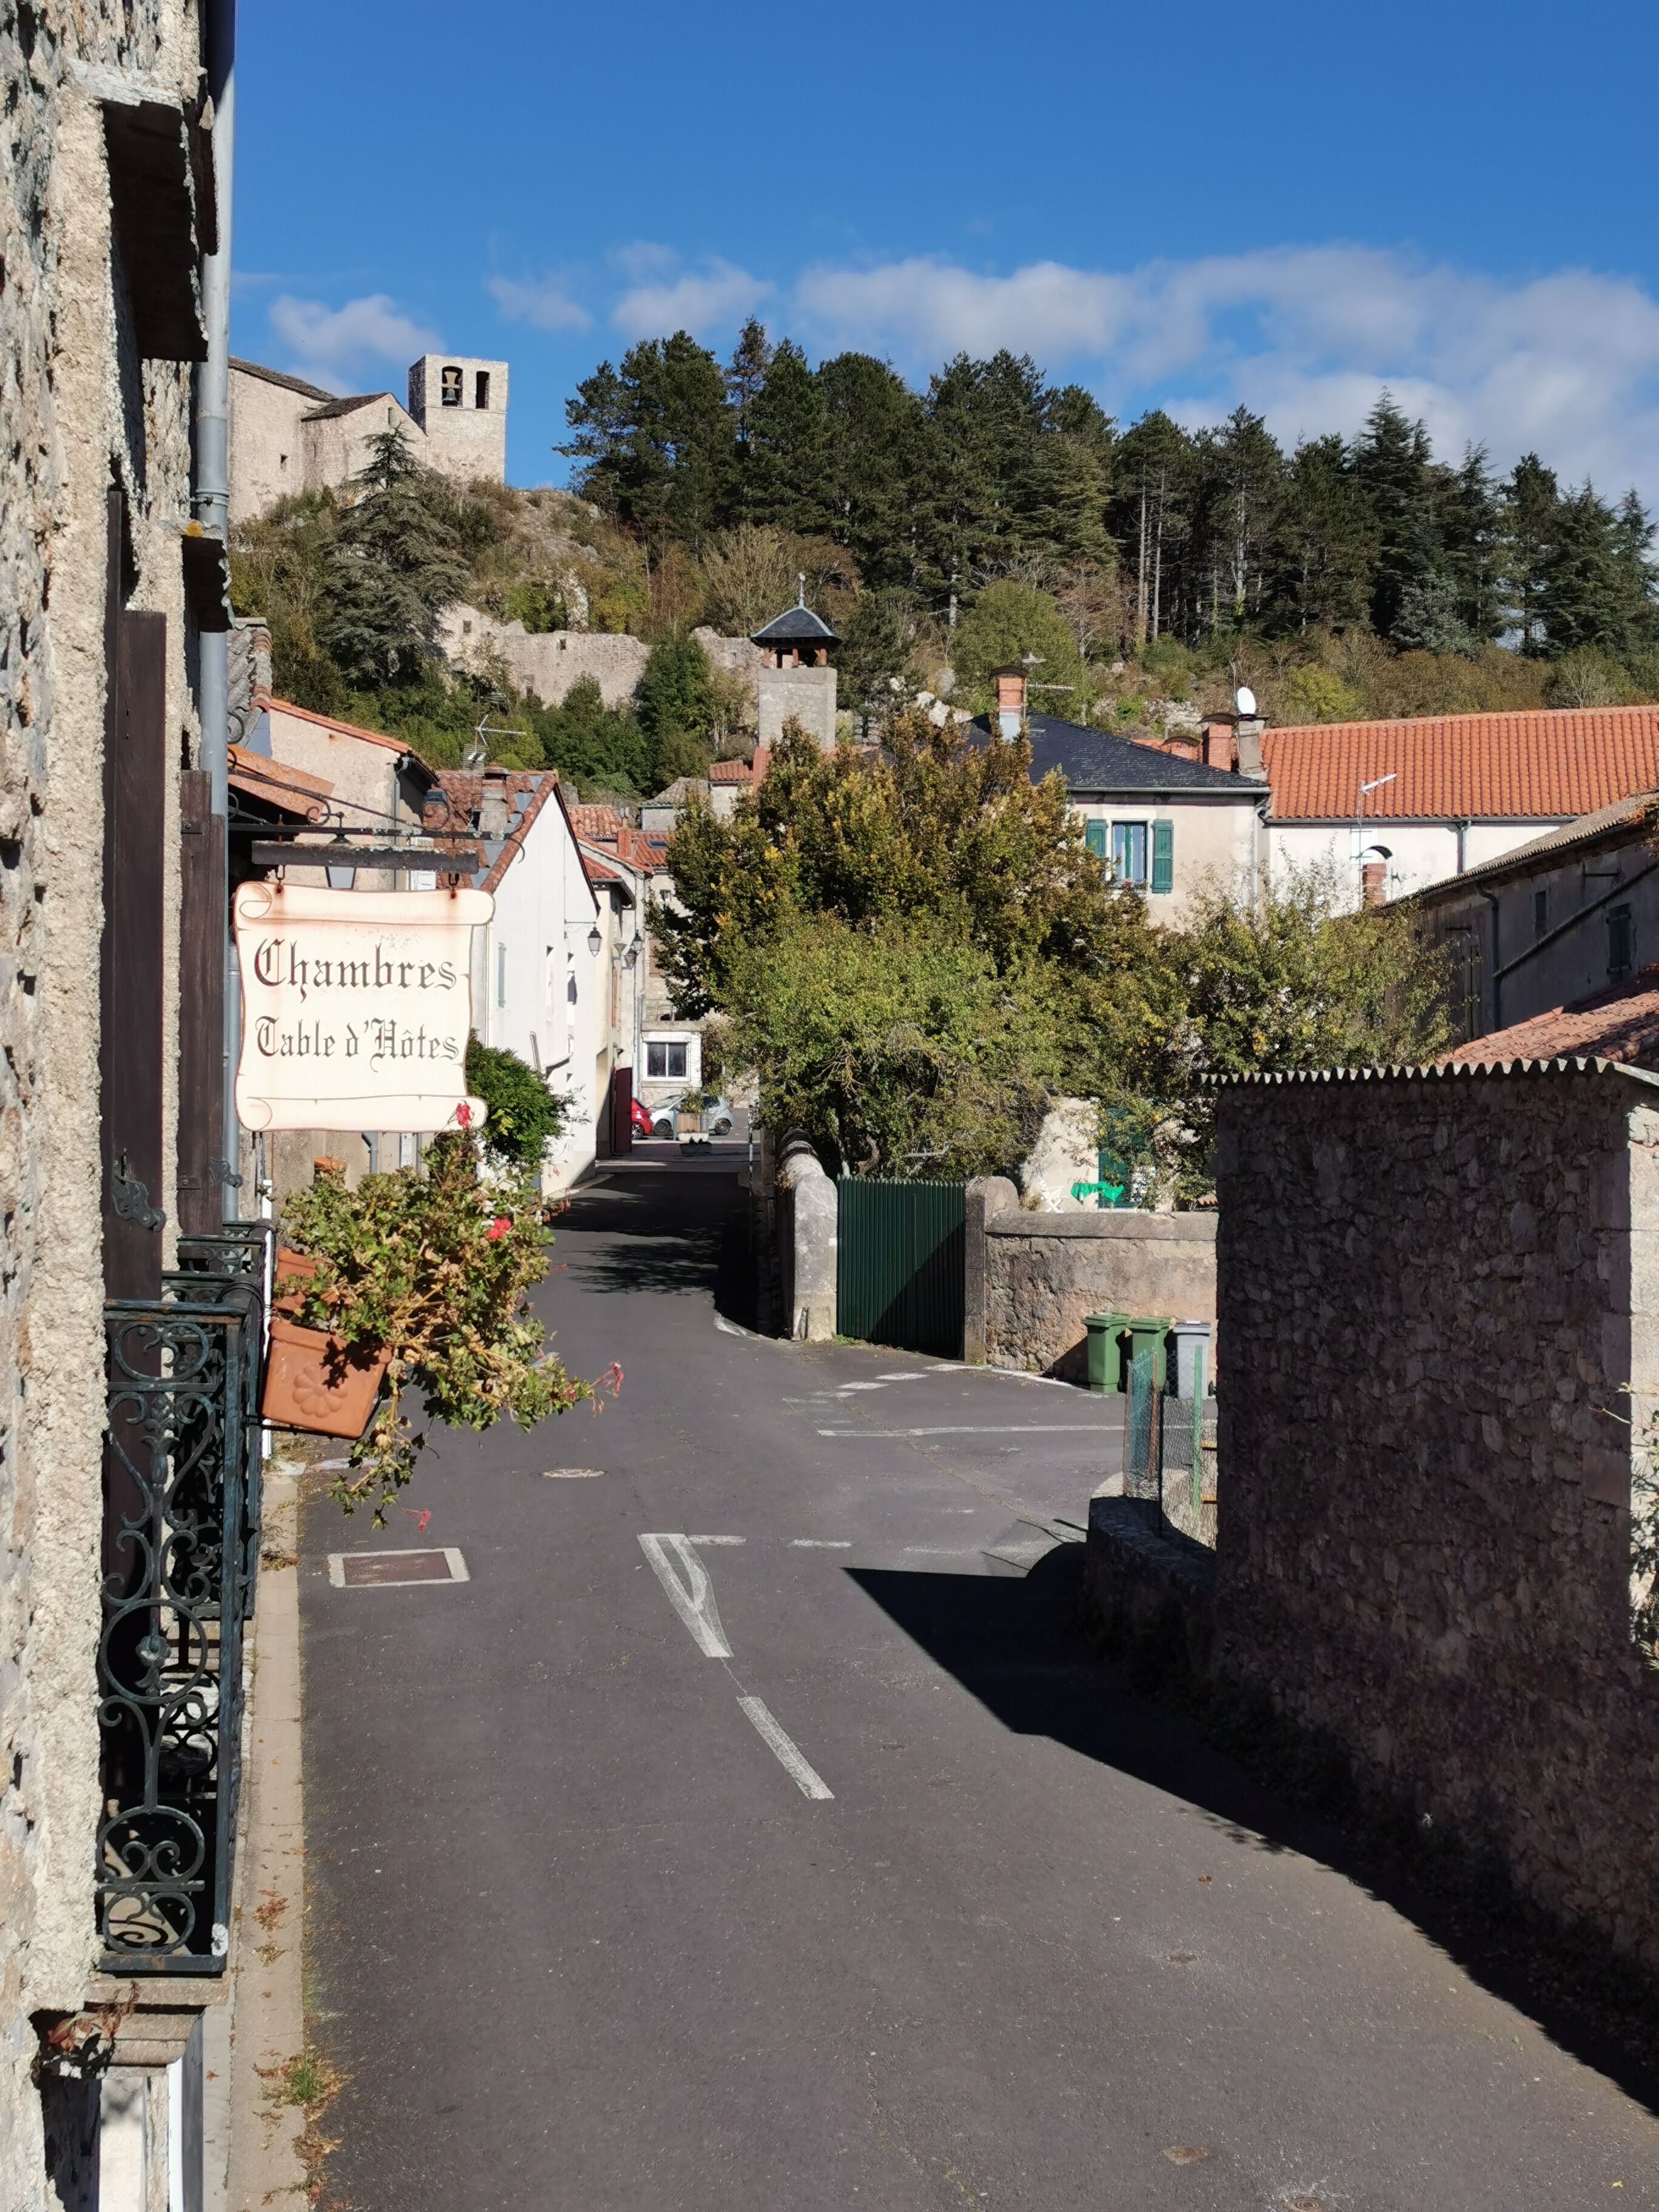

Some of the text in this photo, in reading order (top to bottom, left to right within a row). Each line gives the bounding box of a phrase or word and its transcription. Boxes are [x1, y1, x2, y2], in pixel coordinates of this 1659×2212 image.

[254, 938, 457, 1004] Chambres
[255, 1016, 460, 1073] Table d'Hôtes
